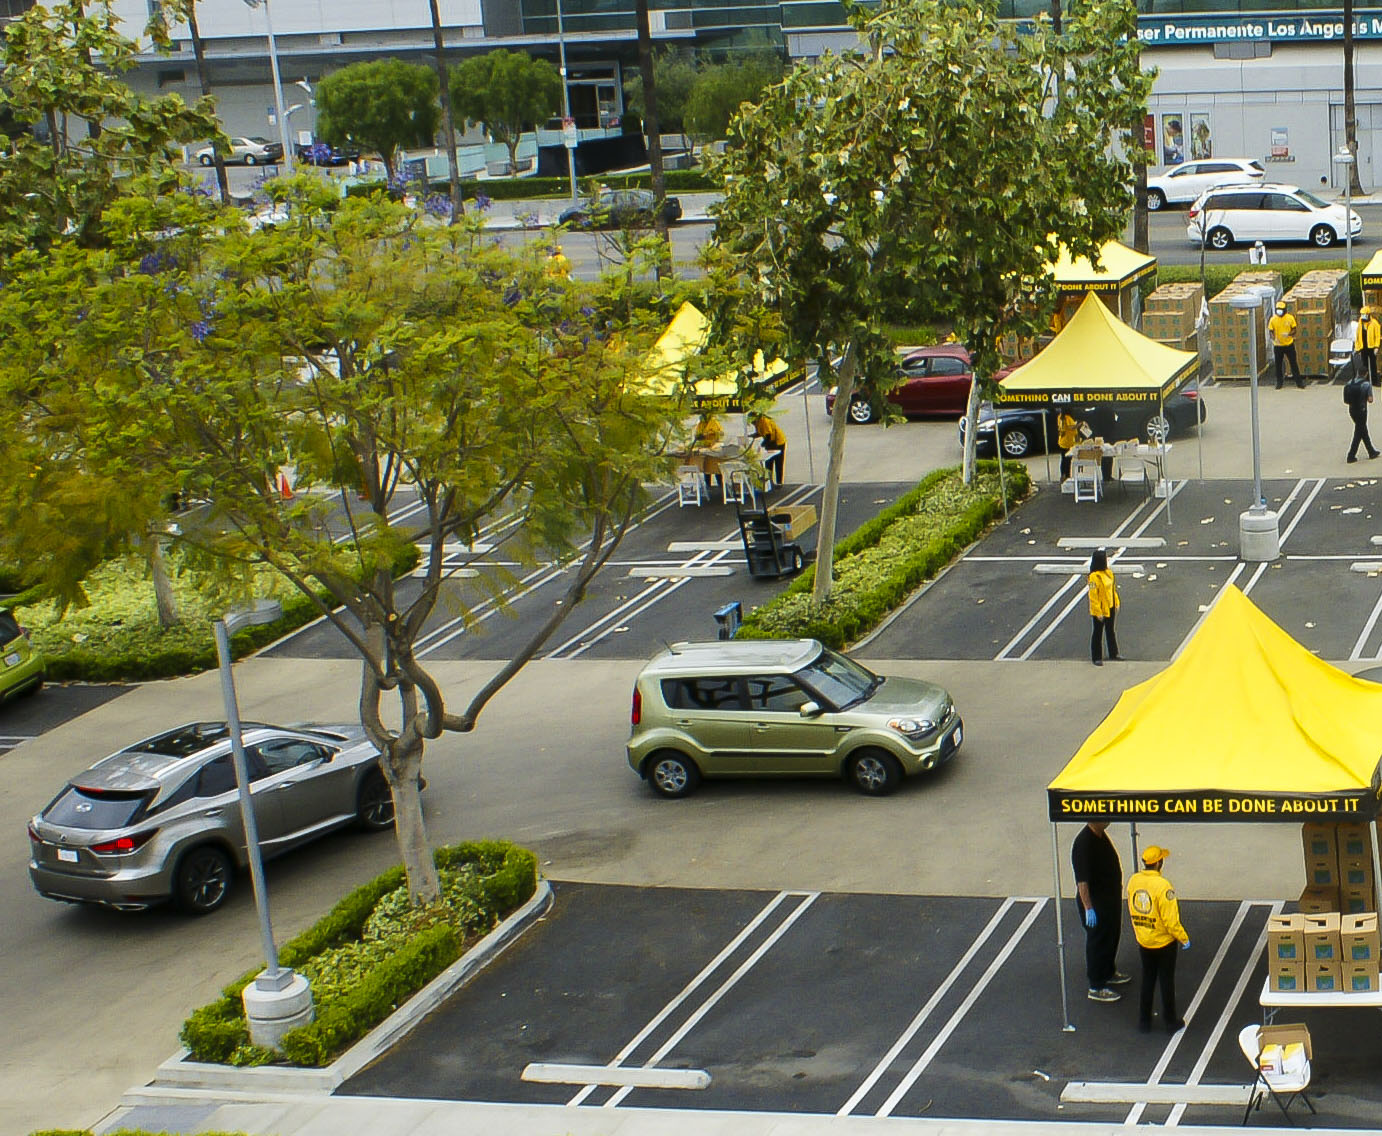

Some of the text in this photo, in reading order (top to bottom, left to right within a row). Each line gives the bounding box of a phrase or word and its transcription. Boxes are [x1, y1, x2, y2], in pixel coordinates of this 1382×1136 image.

[1162, 24, 1265, 41] Permanente
[1267, 21, 1296, 37] Los
[999, 392, 1157, 404] OMETHING CAN BE DONE ABOUT IT
[1060, 798, 1360, 814] SOMETHING CAN BE DONE ABOUT IT
